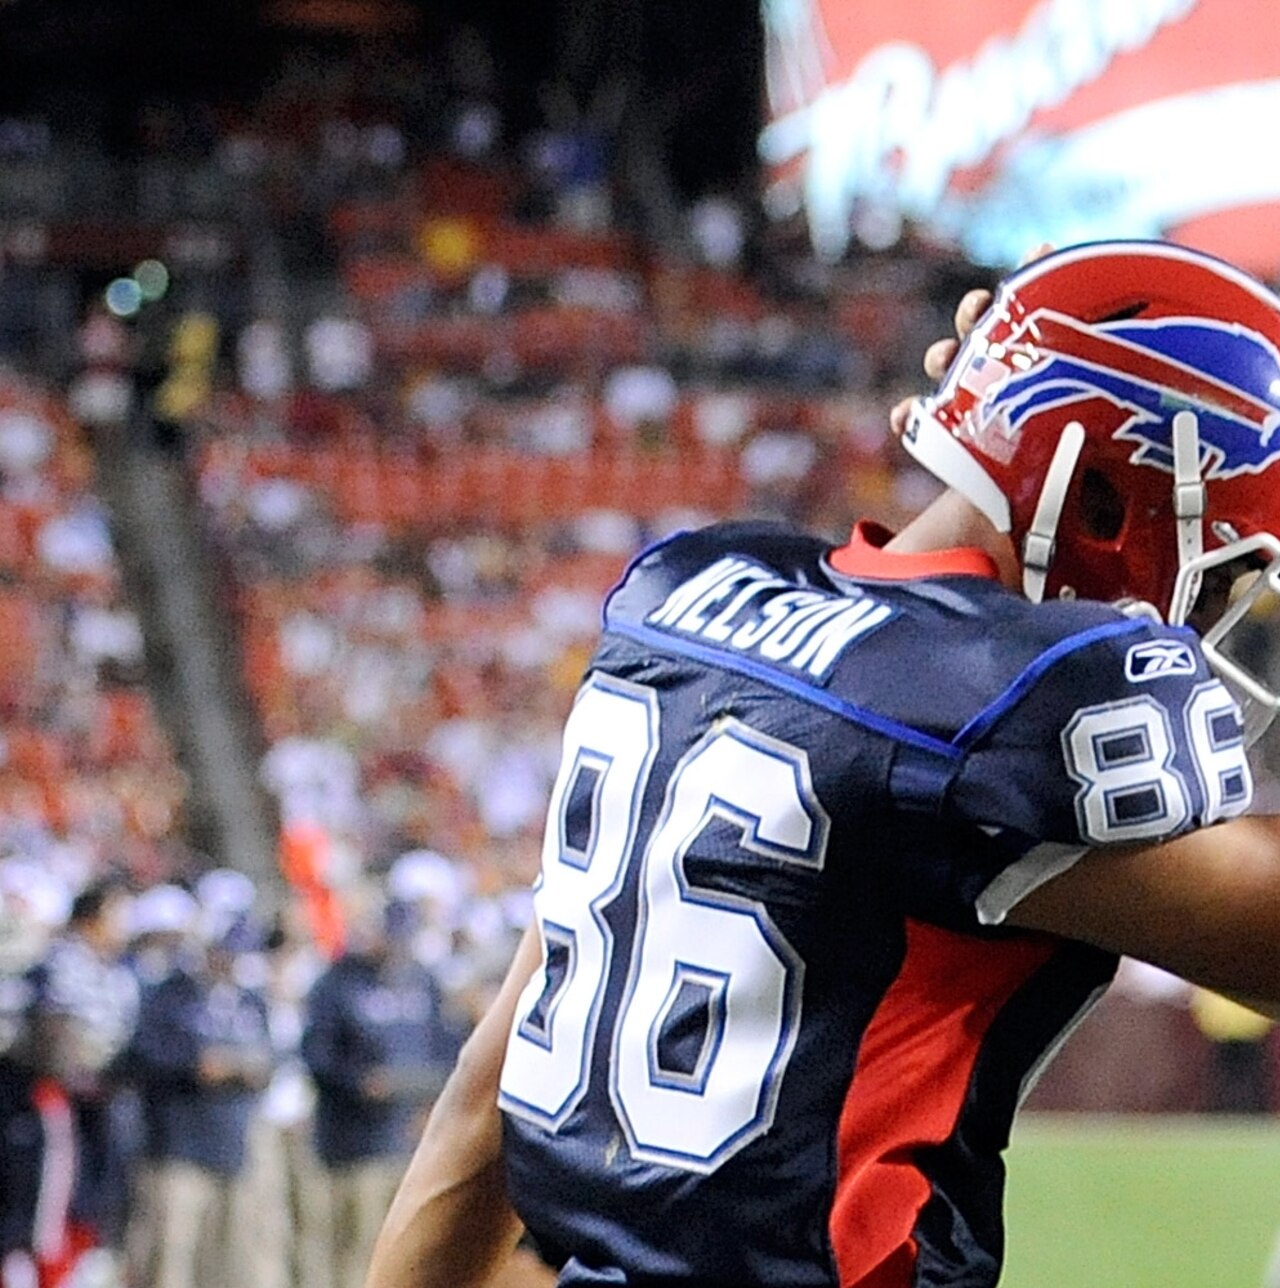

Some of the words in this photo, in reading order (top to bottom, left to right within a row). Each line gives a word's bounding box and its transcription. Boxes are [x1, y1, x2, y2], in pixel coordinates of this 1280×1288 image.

[648, 555, 896, 682] NELSON
[1060, 678, 1254, 844] 86
[498, 670, 832, 1175] 86
